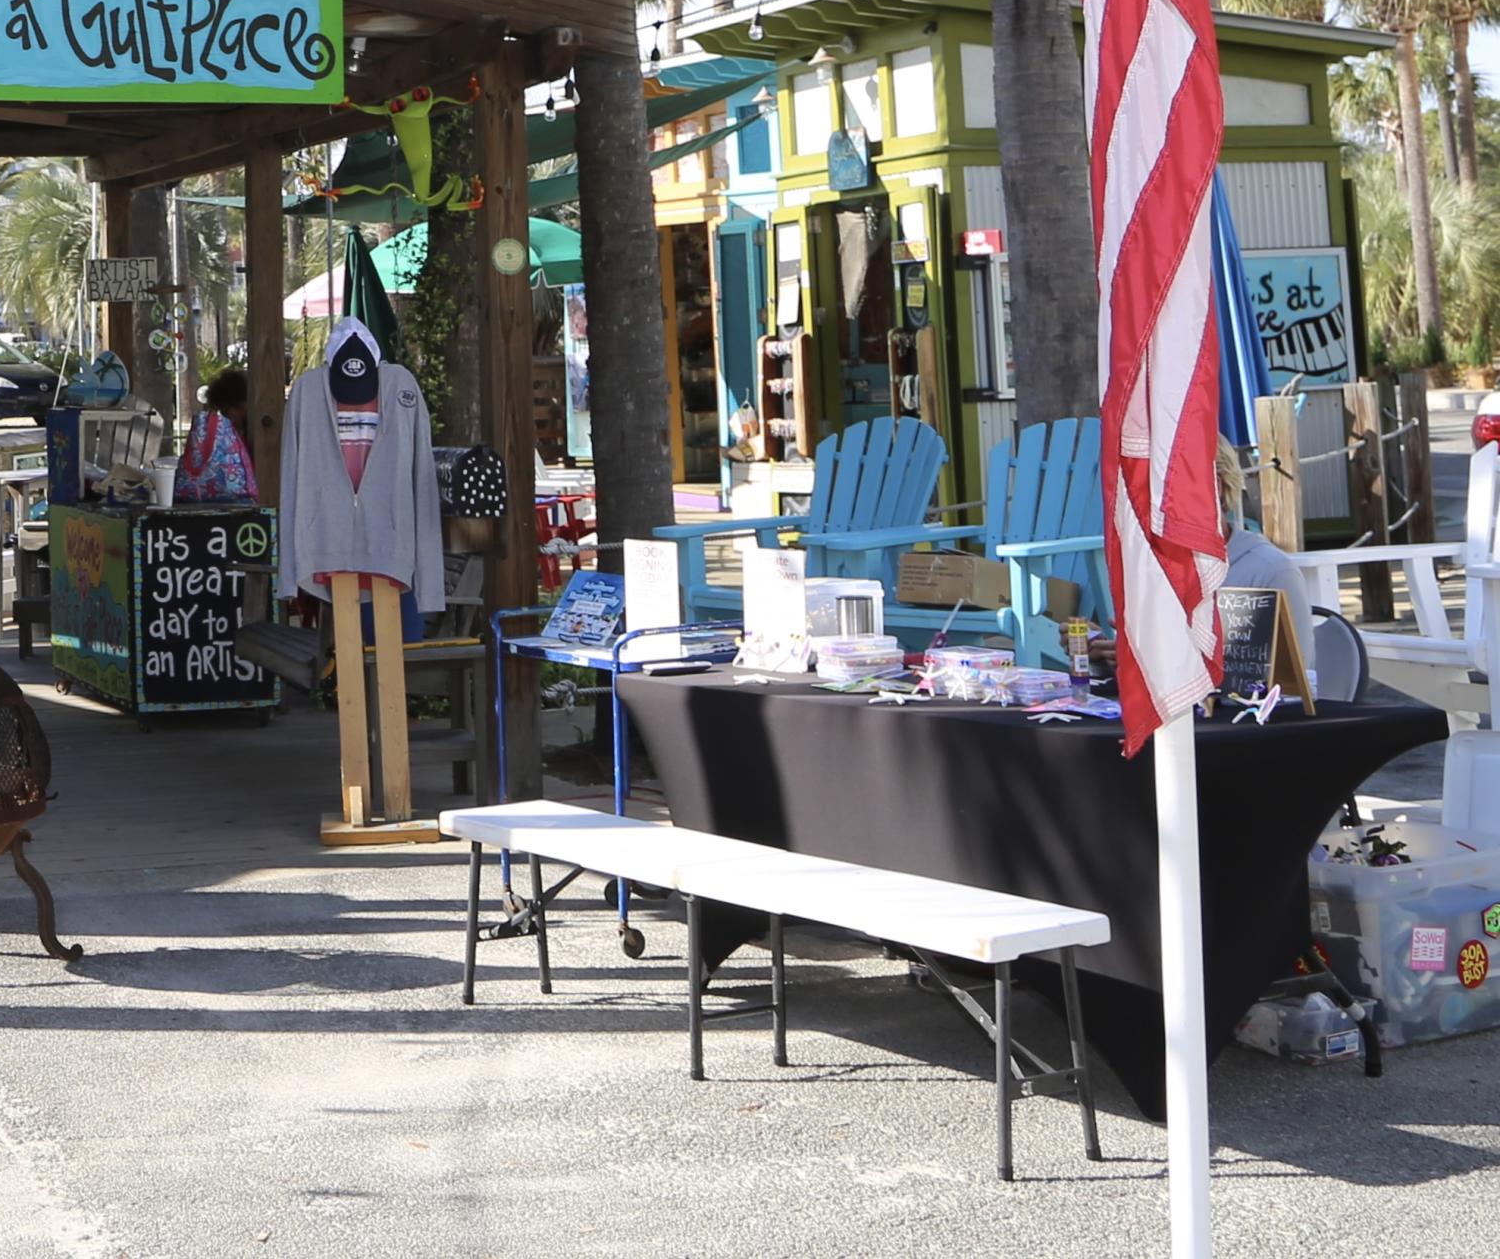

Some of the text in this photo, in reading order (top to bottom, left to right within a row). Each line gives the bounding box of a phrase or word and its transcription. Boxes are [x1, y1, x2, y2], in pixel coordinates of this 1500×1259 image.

[88, 280, 157, 301] BAZAAR
[1287, 266, 1325, 311] at
[146, 526, 227, 564] It's a
[152, 566, 246, 603] great
[1217, 594, 1275, 610] CREATE
[202, 609, 228, 640] to
[1227, 613, 1256, 628] YOUR
[1228, 629, 1252, 642] OWN
[146, 650, 175, 677] an
[1222, 643, 1268, 661] TARFISH
